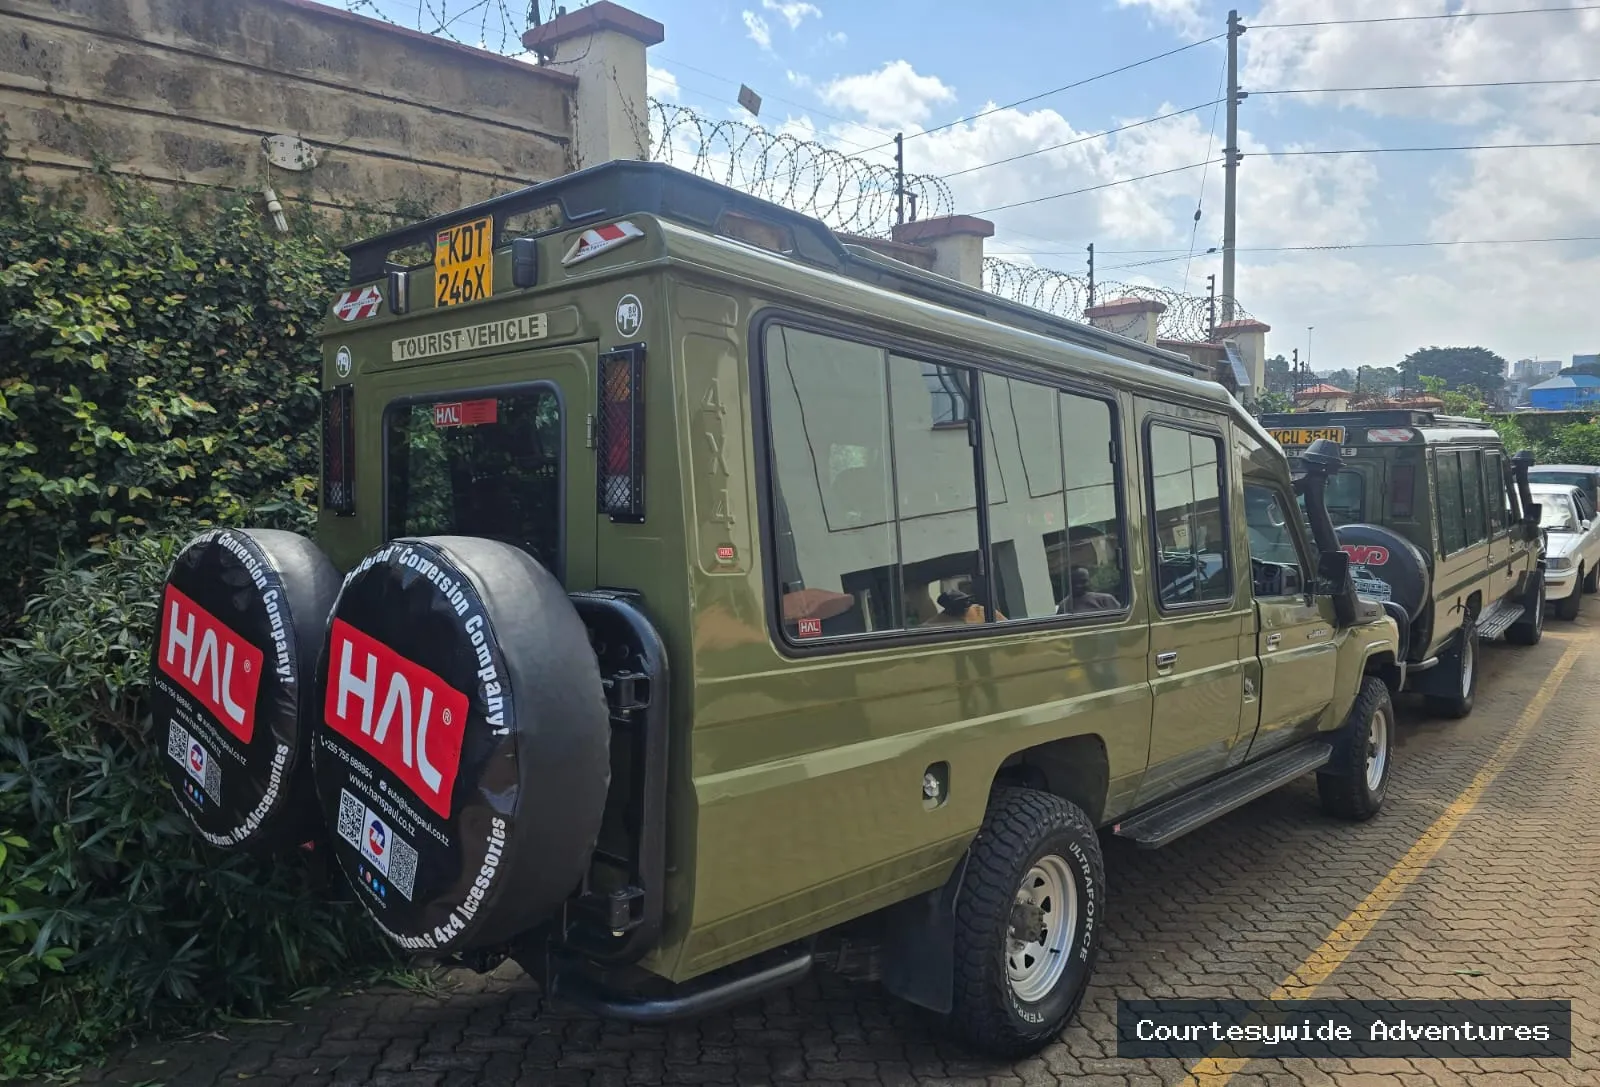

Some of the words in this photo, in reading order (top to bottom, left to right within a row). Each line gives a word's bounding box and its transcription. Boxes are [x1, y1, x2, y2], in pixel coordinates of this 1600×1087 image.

[448, 221, 487, 264] KDT
[438, 263, 486, 306] 246X
[398, 330, 463, 359] TOURIST
[466, 316, 540, 347] VEHICLE
[436, 407, 459, 424] HAL
[1304, 429, 1338, 444] 351H
[217, 532, 268, 590] Conversion
[262, 589, 295, 683] Company!
[398, 547, 470, 617] Conversion
[465, 614, 510, 736] Company!
[800, 624, 819, 633] HAL
[166, 599, 247, 726] HAL
[335, 638, 443, 795] HAL
[249, 744, 289, 822] Accessories
[349, 772, 416, 837] www.hanspaul.co.tz
[434, 913, 466, 944] 4x4
[456, 817, 506, 920] Accessories
[1069, 841, 1095, 962] ULTRAFORCE
